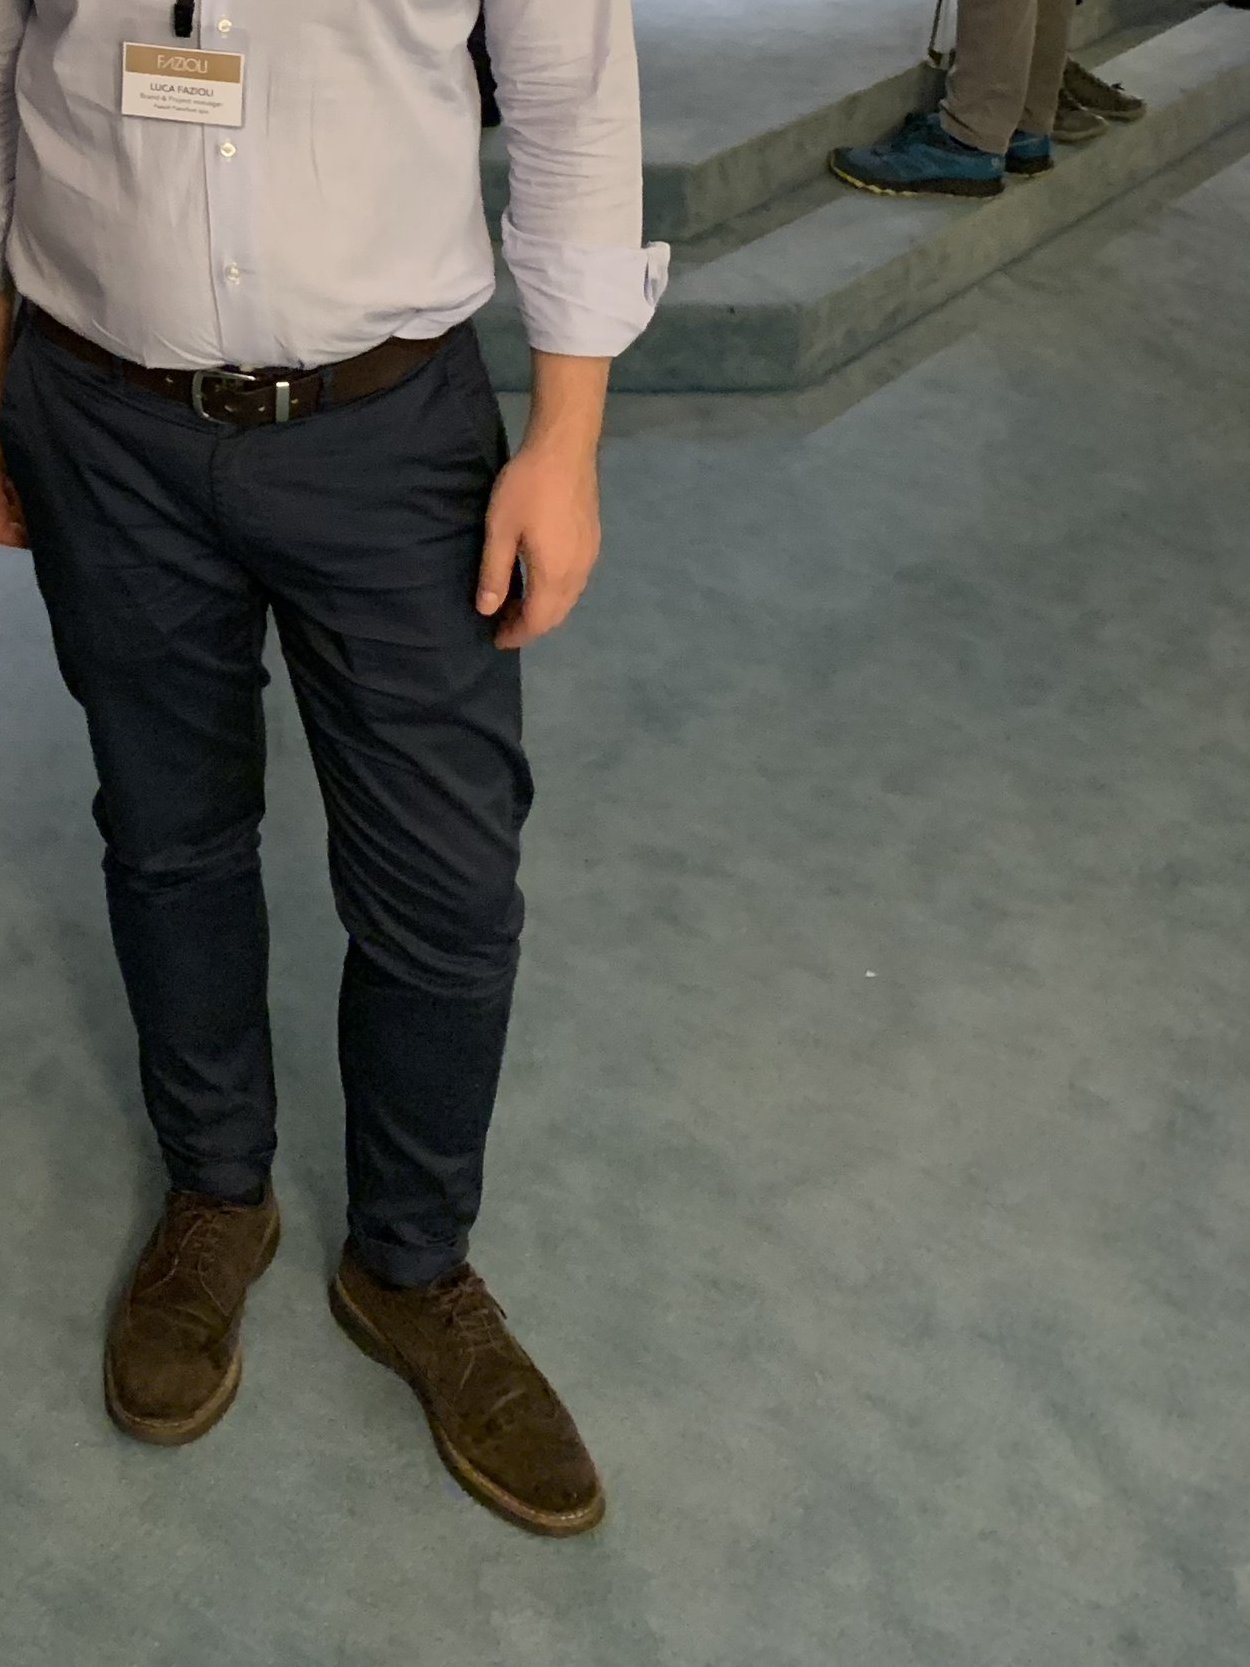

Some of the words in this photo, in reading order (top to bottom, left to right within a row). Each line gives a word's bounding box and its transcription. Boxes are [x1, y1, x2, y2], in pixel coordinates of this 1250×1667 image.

[157, 54, 209, 74] FAZIOLI
[150, 83, 175, 93] LUCA
[177, 85, 214, 97] FAZIOLI
